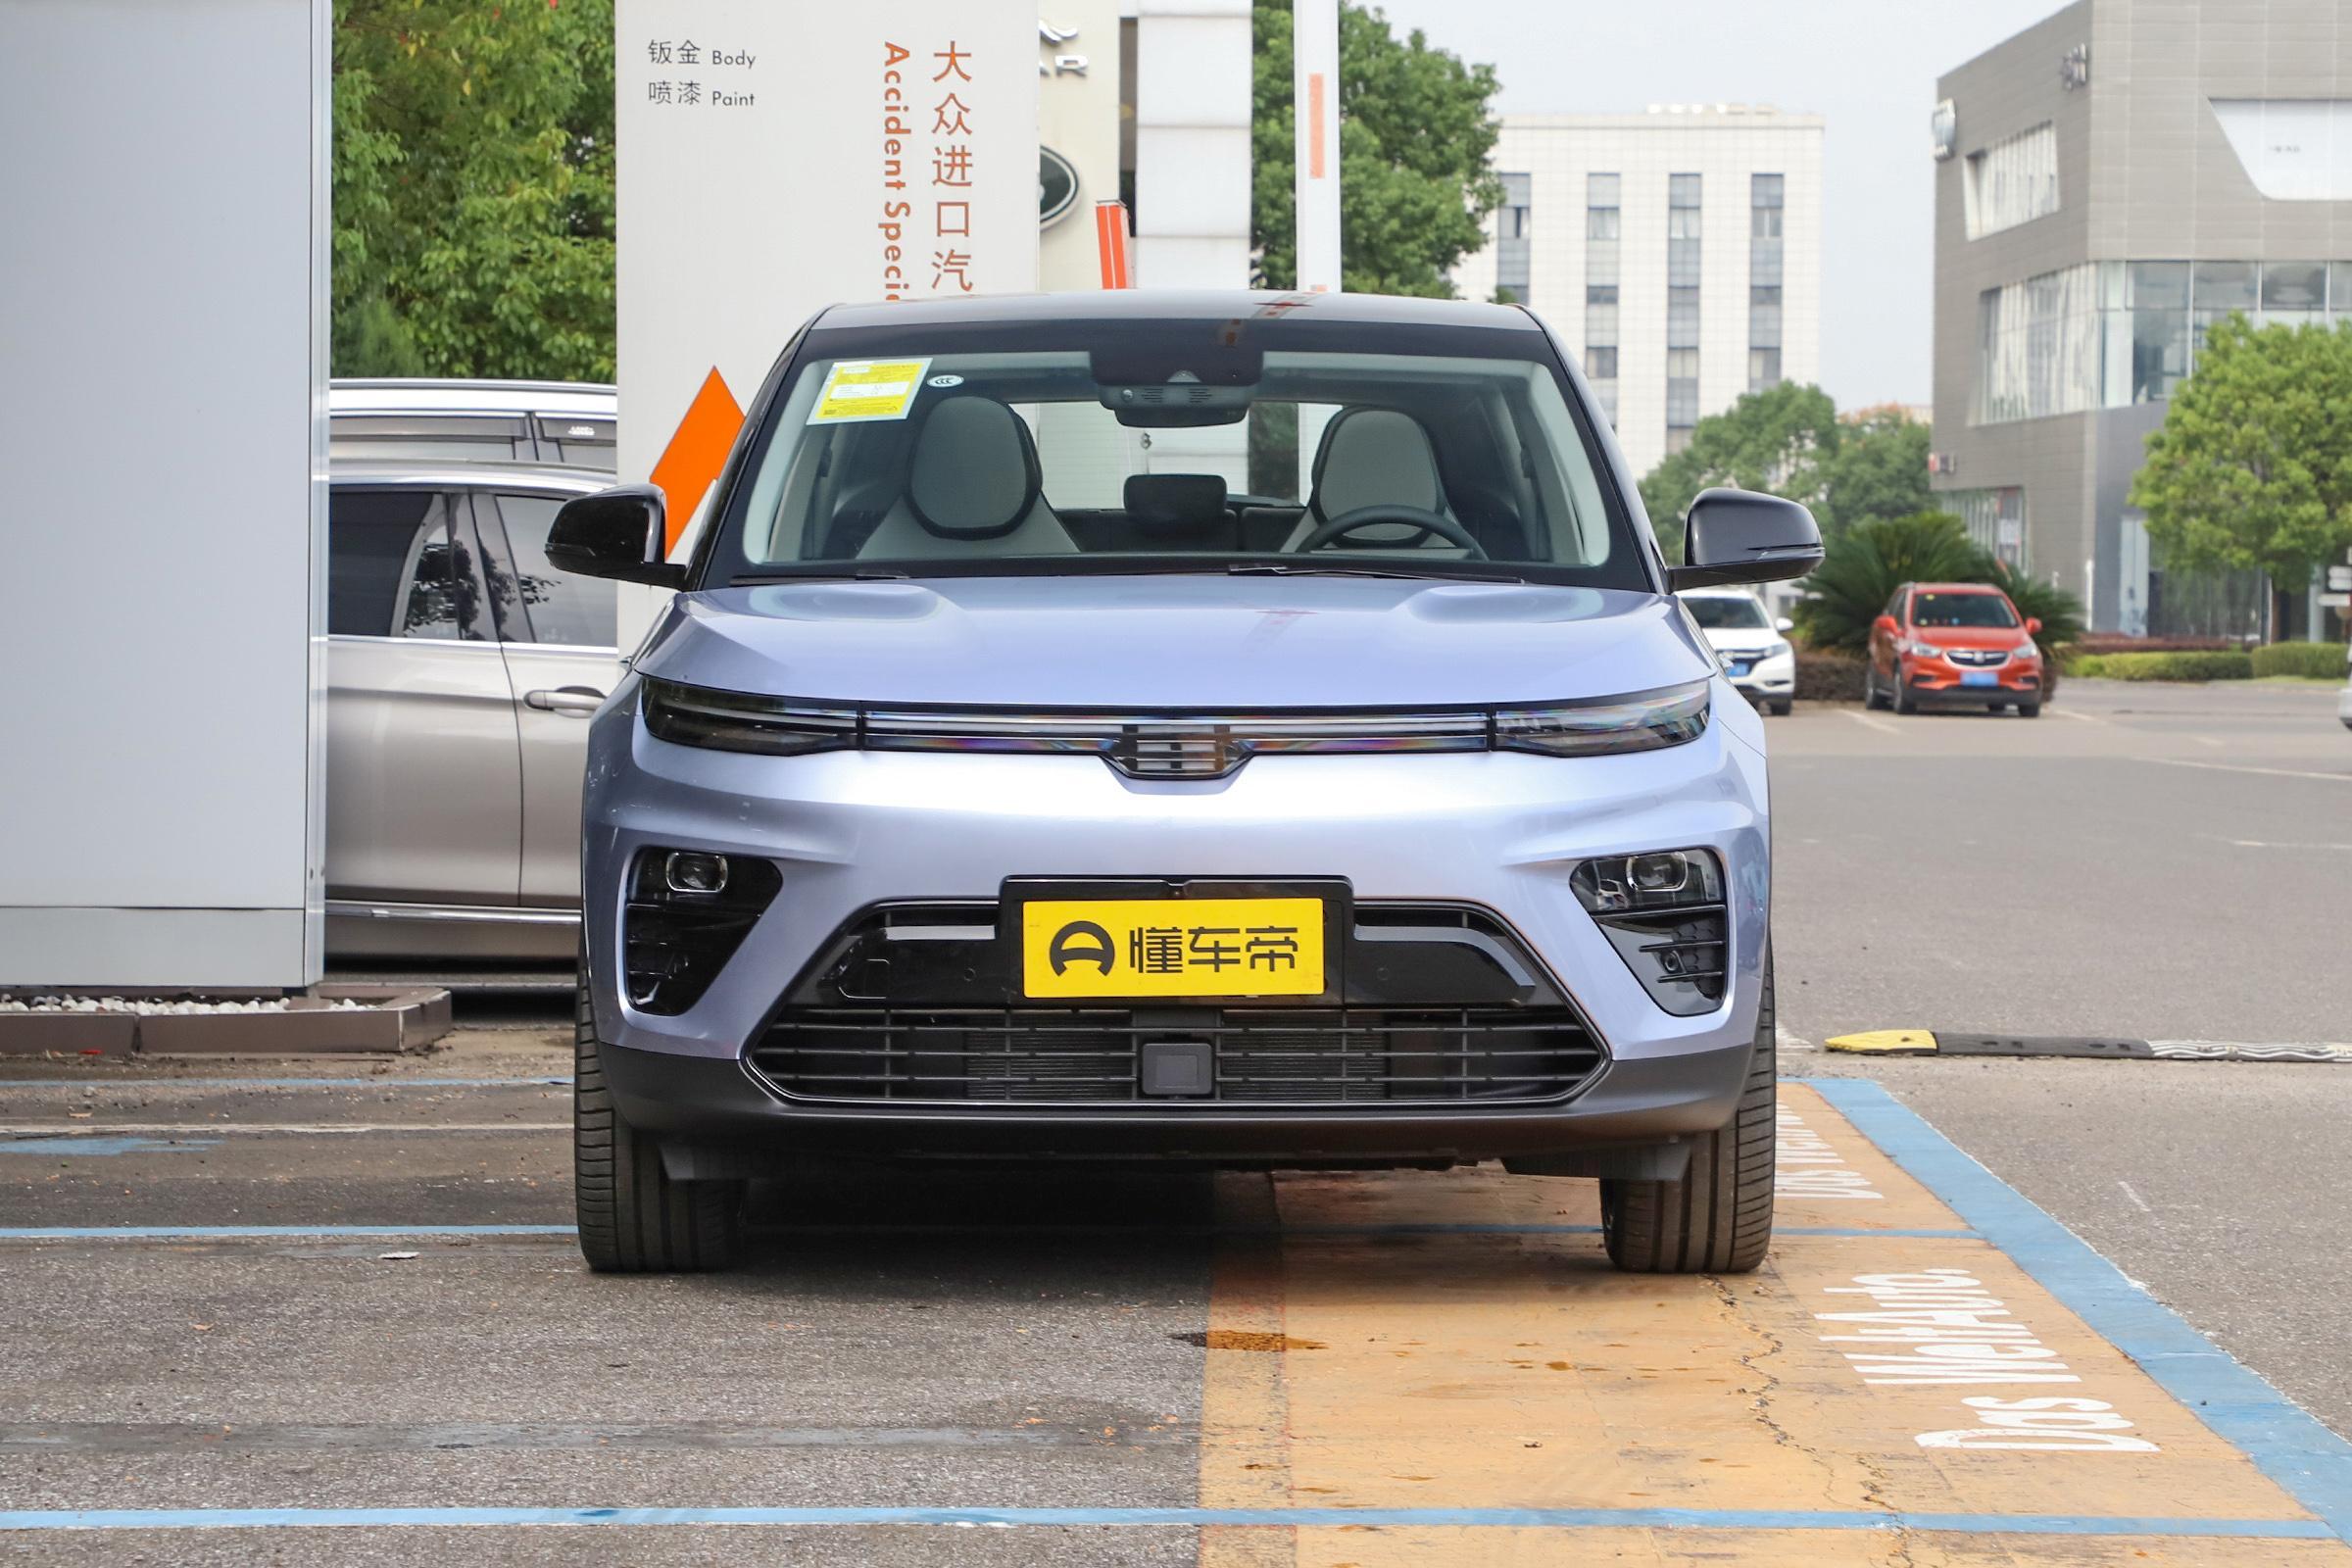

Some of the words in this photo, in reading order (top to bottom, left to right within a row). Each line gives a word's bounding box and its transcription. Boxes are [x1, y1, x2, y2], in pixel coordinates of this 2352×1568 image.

[648, 39, 701, 64] 钣金
[712, 49, 756, 70] Body
[648, 80, 701, 105] 喷漆
[712, 90, 755, 106] Paint
[884, 41, 911, 190] Accident
[931, 40, 972, 291] 大众进口汽
[1129, 925, 1298, 973] 懂车帝
[1813, 1268, 2083, 1385] WeltAuto.
[1914, 1396, 2162, 1452] Das
